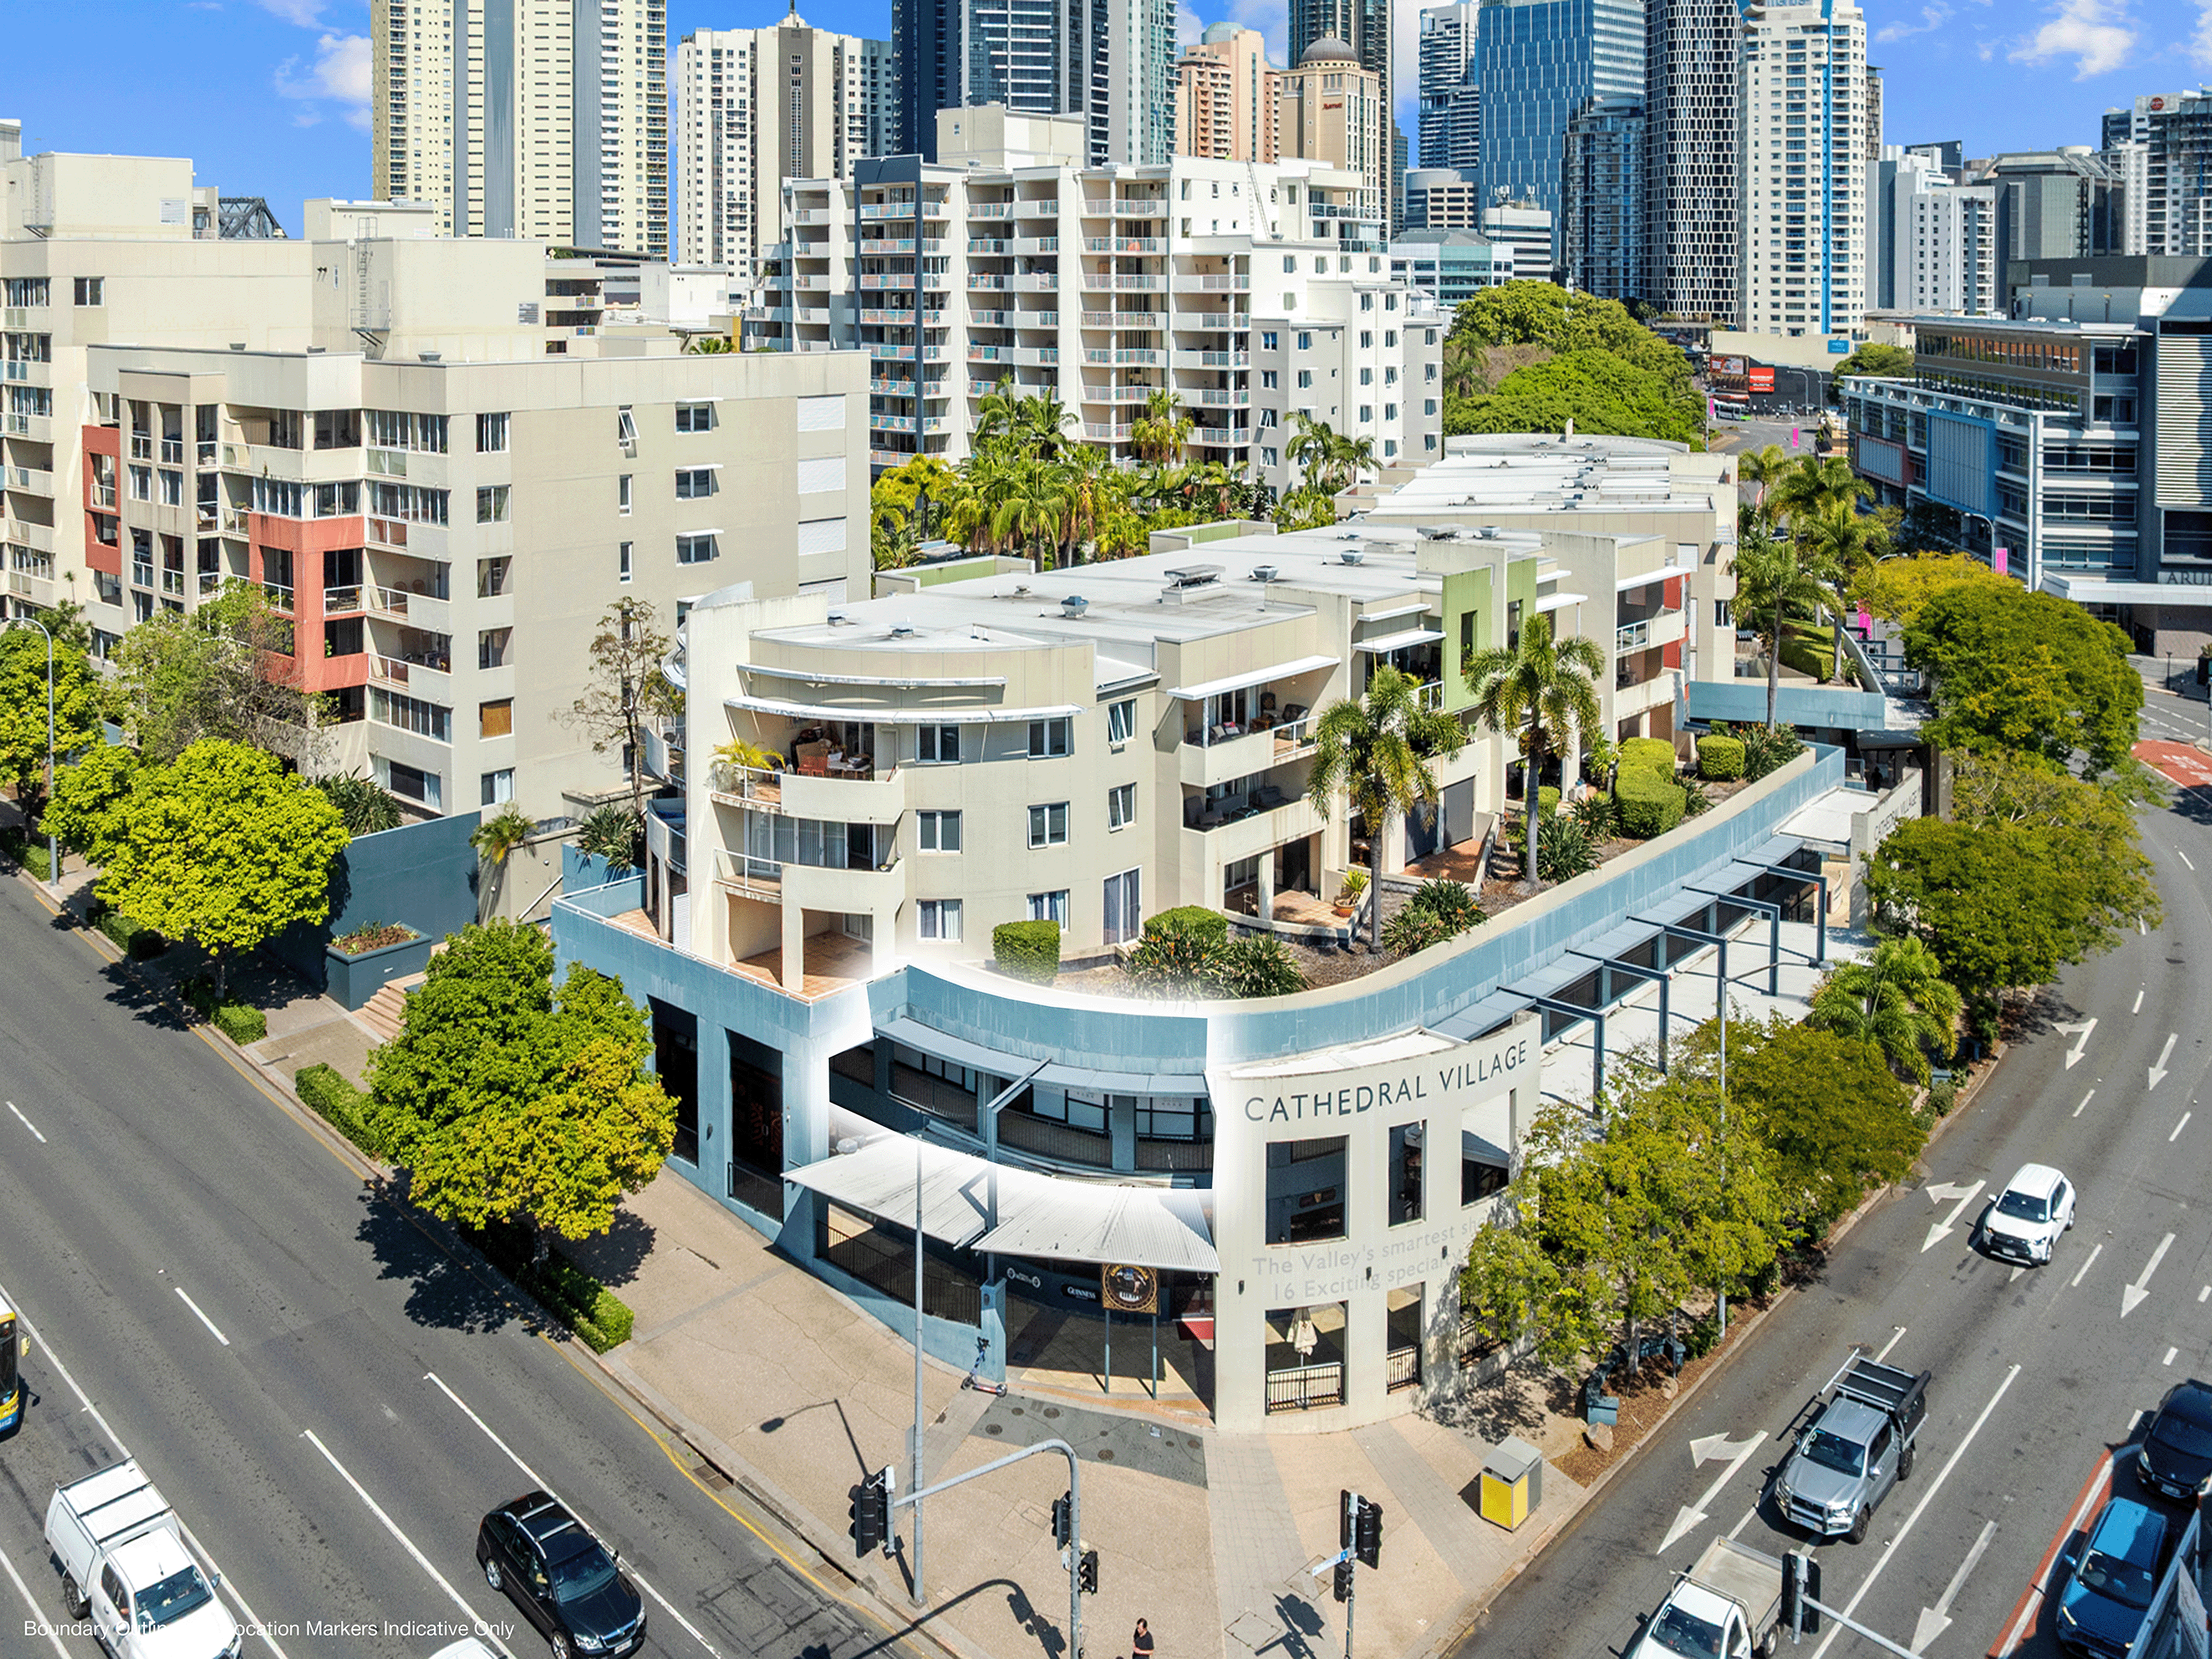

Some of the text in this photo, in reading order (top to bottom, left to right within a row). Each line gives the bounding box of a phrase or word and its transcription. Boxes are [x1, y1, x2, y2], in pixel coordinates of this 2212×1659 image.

[2167, 570, 2212, 585] ARU
[1245, 1040, 1527, 1122] CATHEDRAL VILLAGE
[1252, 1257, 1293, 1275] The
[1301, 1244, 1374, 1271] Valley's
[1382, 1226, 1455, 1258] smartest
[1274, 1283, 1295, 1300] 16
[1305, 1272, 1381, 1298] Exciting
